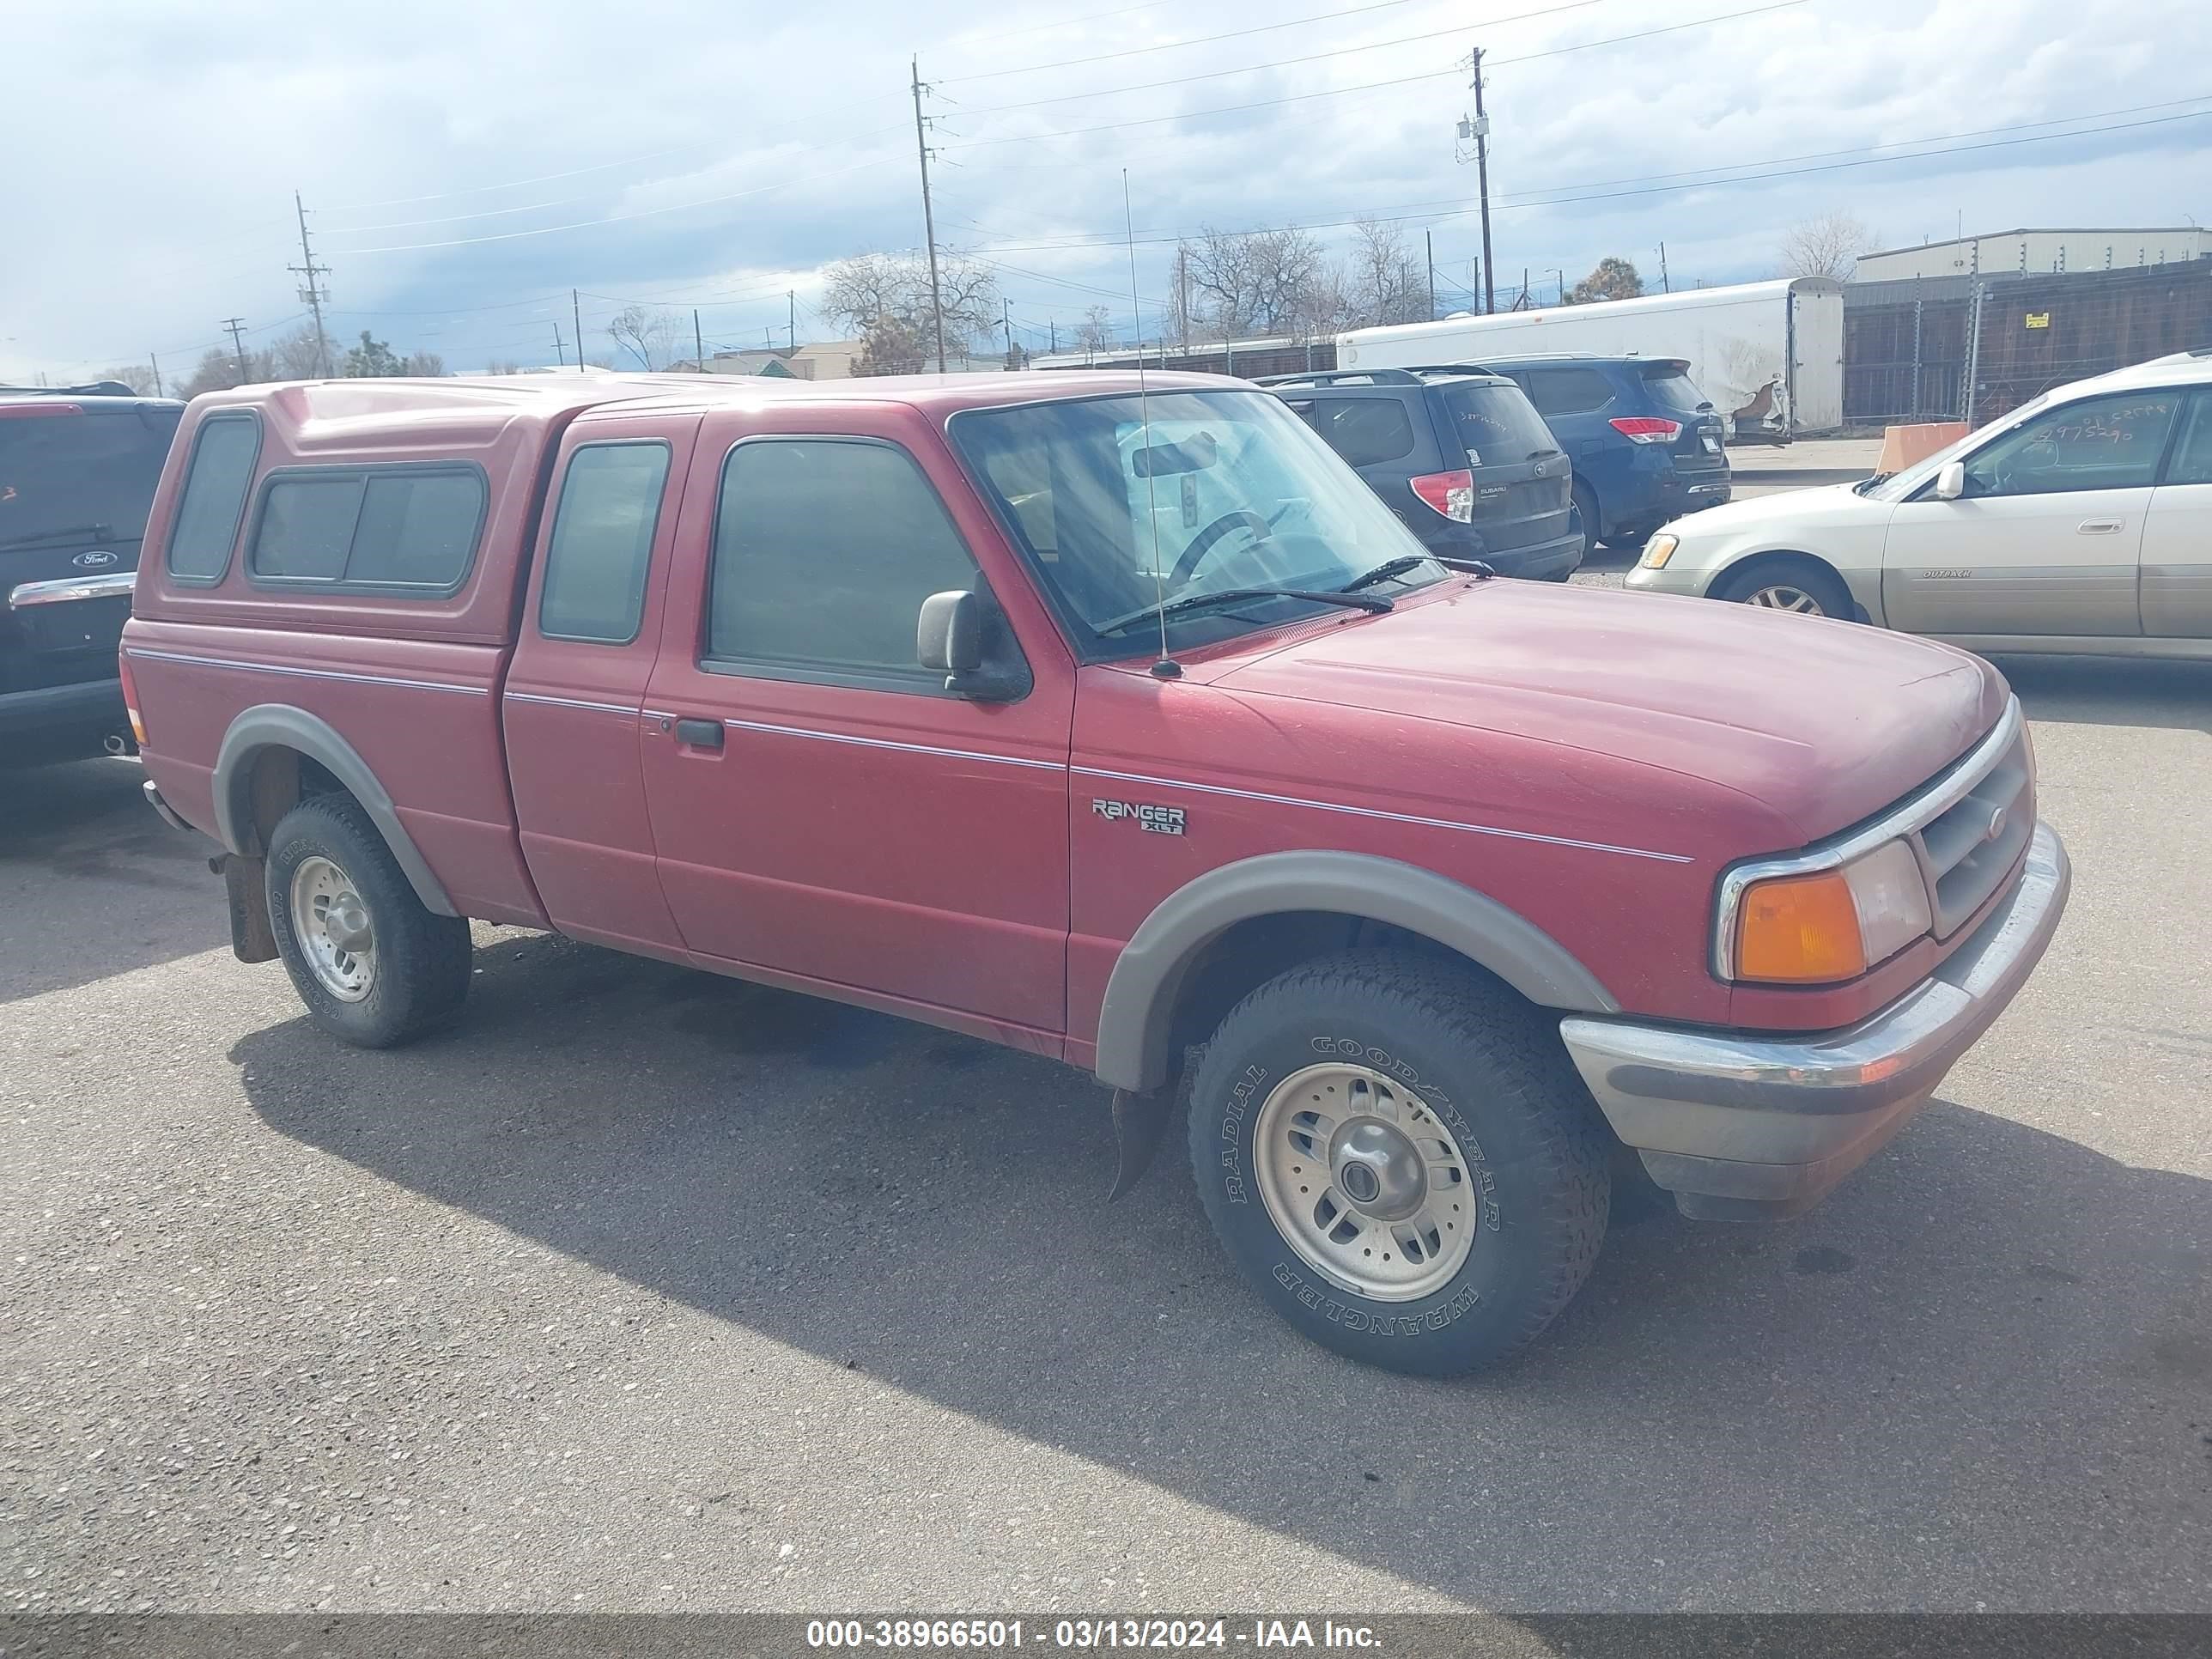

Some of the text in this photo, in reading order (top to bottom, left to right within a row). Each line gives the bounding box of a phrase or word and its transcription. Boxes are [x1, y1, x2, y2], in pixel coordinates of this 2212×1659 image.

[1480, 486, 1506, 495] SUBARU
[84, 554, 107, 564] Ford
[1923, 569, 1972, 578] OUTBACK
[1092, 799, 1184, 824] RANGER
[1146, 822, 1178, 833] XLT
[1221, 1064, 1269, 1205] RADIAL
[1272, 1261, 1480, 1337] WRANGLER
